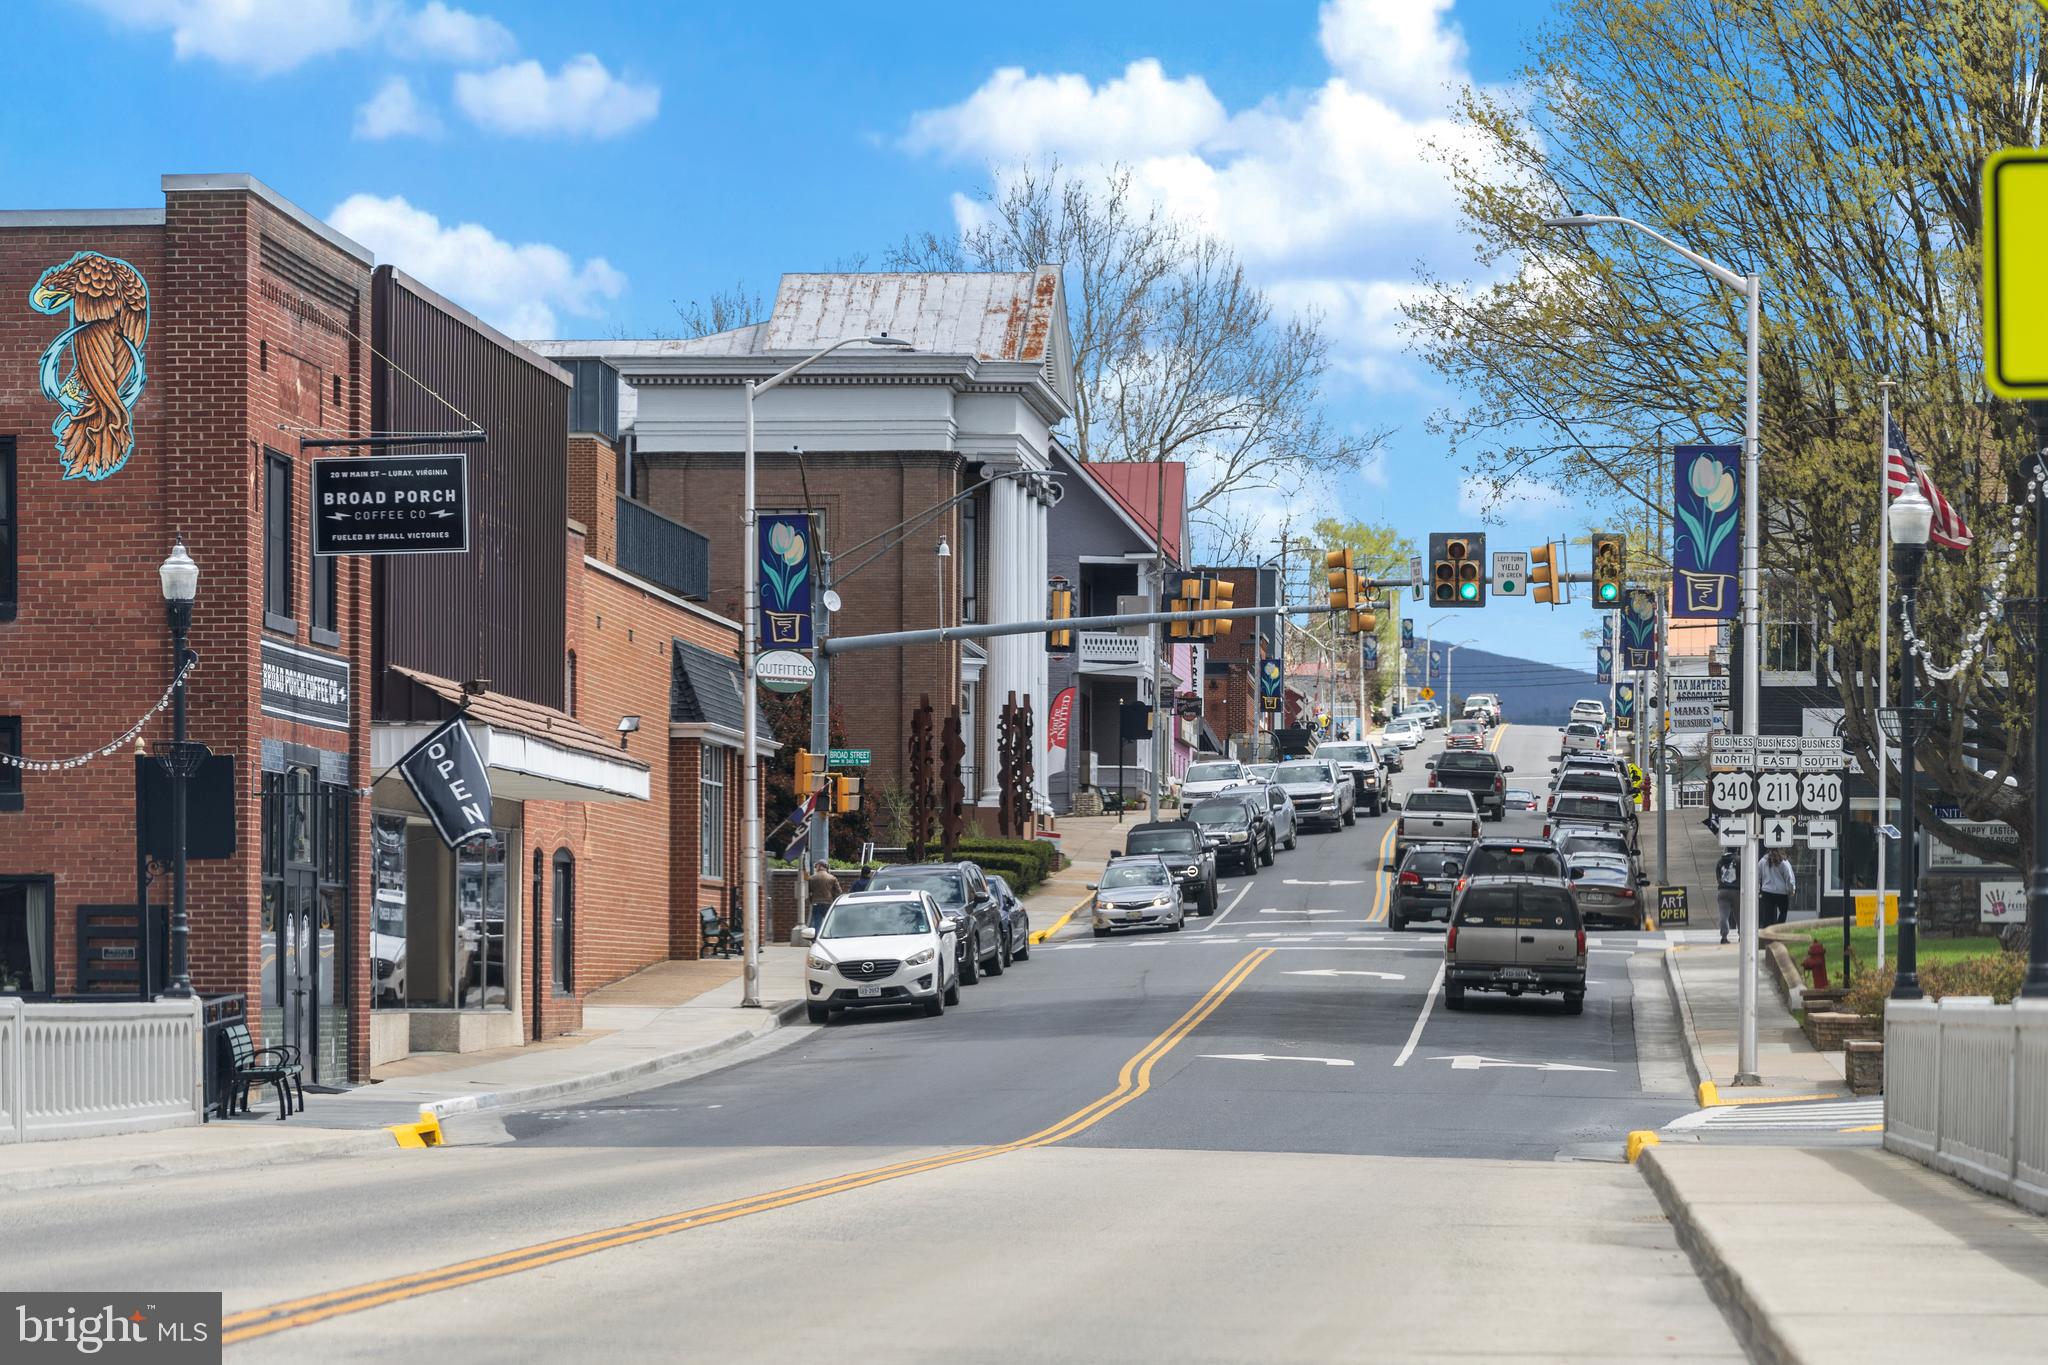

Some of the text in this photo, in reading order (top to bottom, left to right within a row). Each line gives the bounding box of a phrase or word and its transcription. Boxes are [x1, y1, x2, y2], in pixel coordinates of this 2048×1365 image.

[416, 468, 448, 476] VIRGINIA
[323, 489, 456, 505] BROAD PORCH
[354, 510, 426, 521] COFFEE CO
[332, 533, 363, 541] FUELED
[378, 532, 405, 540] SMALL
[407, 531, 449, 539] VICTORIES
[759, 663, 814, 677] OUTFITTERS
[1673, 679, 1726, 690] TAX MATTERS
[1674, 706, 1710, 716] MAMA'S
[1057, 694, 1071, 741] INVITED
[1673, 718, 1712, 728] TREASURES
[1714, 737, 1753, 747] BUSINESS
[1757, 738, 1797, 748] BUSINESS
[1801, 739, 1841, 749] BUSINESS
[830, 751, 870, 760] BROAD STREET
[1715, 755, 1750, 764] NORTH
[1763, 757, 1791, 765] EAST
[1804, 757, 1839, 766] SOUTH
[427, 743, 486, 825] OPEN
[1717, 781, 1748, 801] 340
[1766, 782, 1790, 802] 211
[1807, 783, 1838, 802] 340
[1961, 826, 1985, 836] HAPPY
[1661, 896, 1685, 908] ART
[1660, 908, 1686, 919] OPEN
